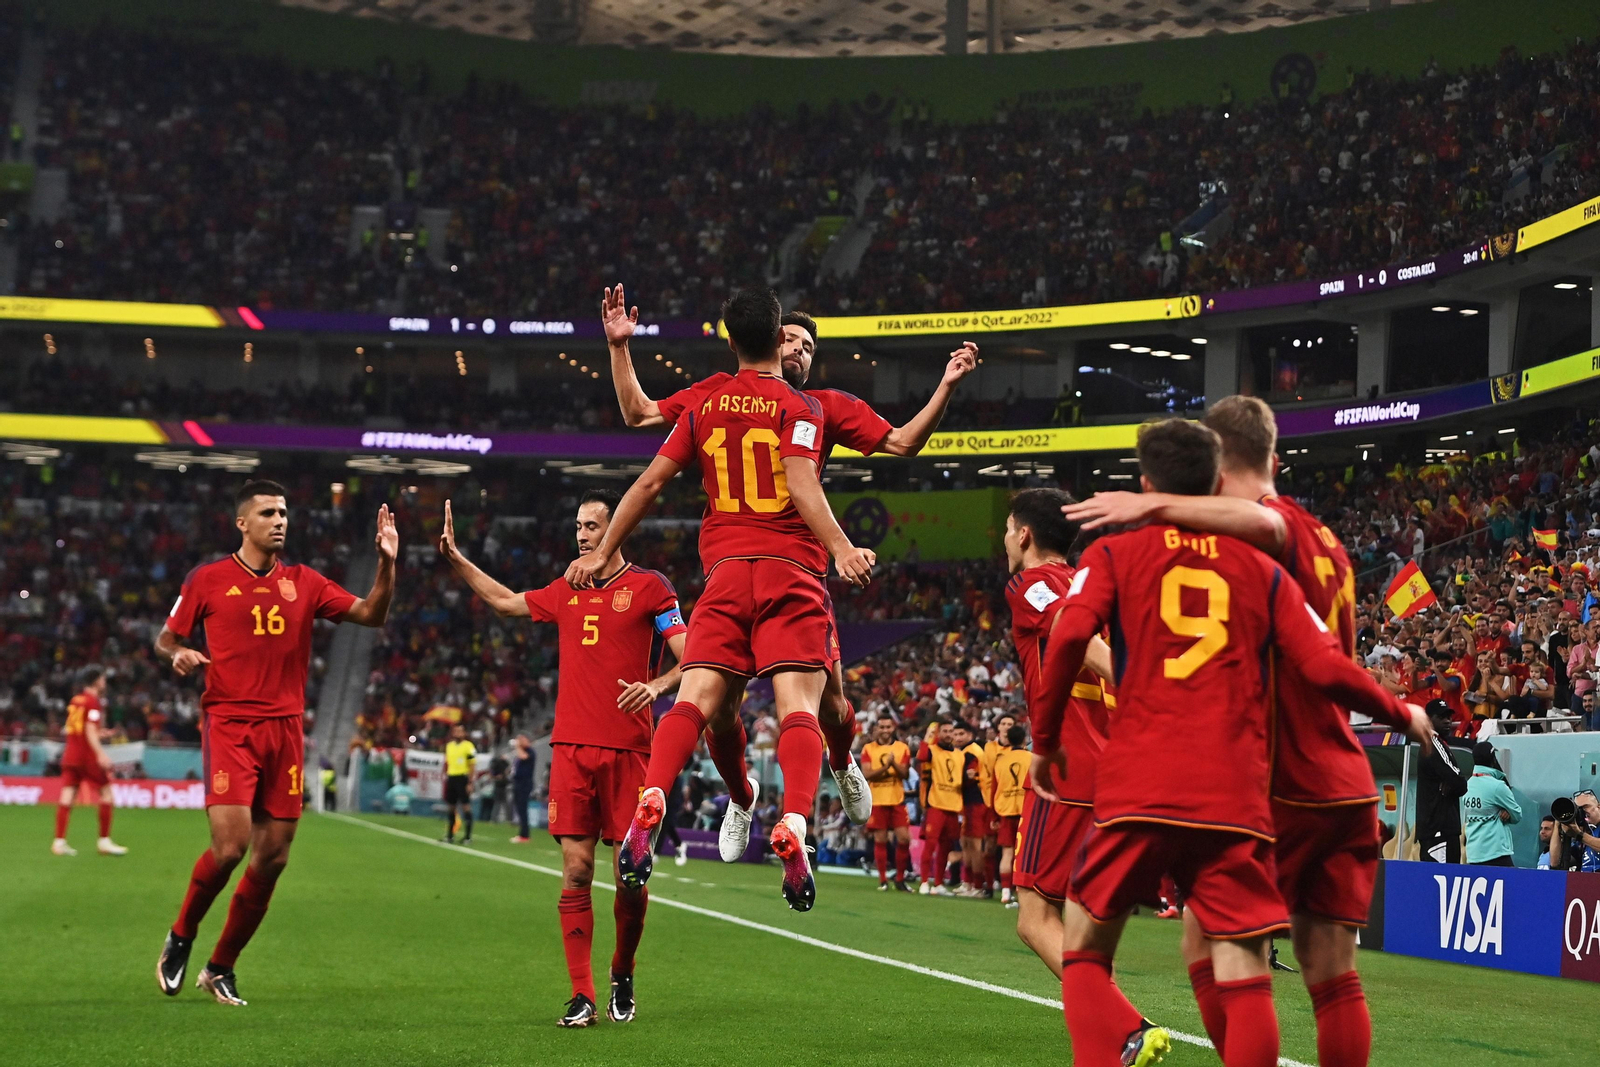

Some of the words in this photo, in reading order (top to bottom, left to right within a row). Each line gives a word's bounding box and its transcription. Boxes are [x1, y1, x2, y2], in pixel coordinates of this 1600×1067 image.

[1583, 204, 1597, 220] FIFA
[1319, 280, 1345, 295] SPAIN
[1357, 274, 1364, 288] 1
[1378, 270, 1387, 285] 0
[1397, 265, 1421, 281] COSTA
[1421, 262, 1436, 277] RICA
[1463, 250, 1478, 264] 20:41
[877, 319, 902, 331] FIFA
[904, 318, 945, 330] WORLD
[947, 317, 969, 328] CUP
[1334, 401, 1420, 426] #FIFAWorldCup
[928, 438, 953, 450] CUP
[702, 427, 791, 512] 10
[251, 604, 285, 635] 16
[581, 615, 600, 645] 5
[1160, 565, 1230, 680] 9
[288, 764, 304, 795] 1
[111, 783, 153, 808] We
[1433, 875, 1504, 955] VISA
